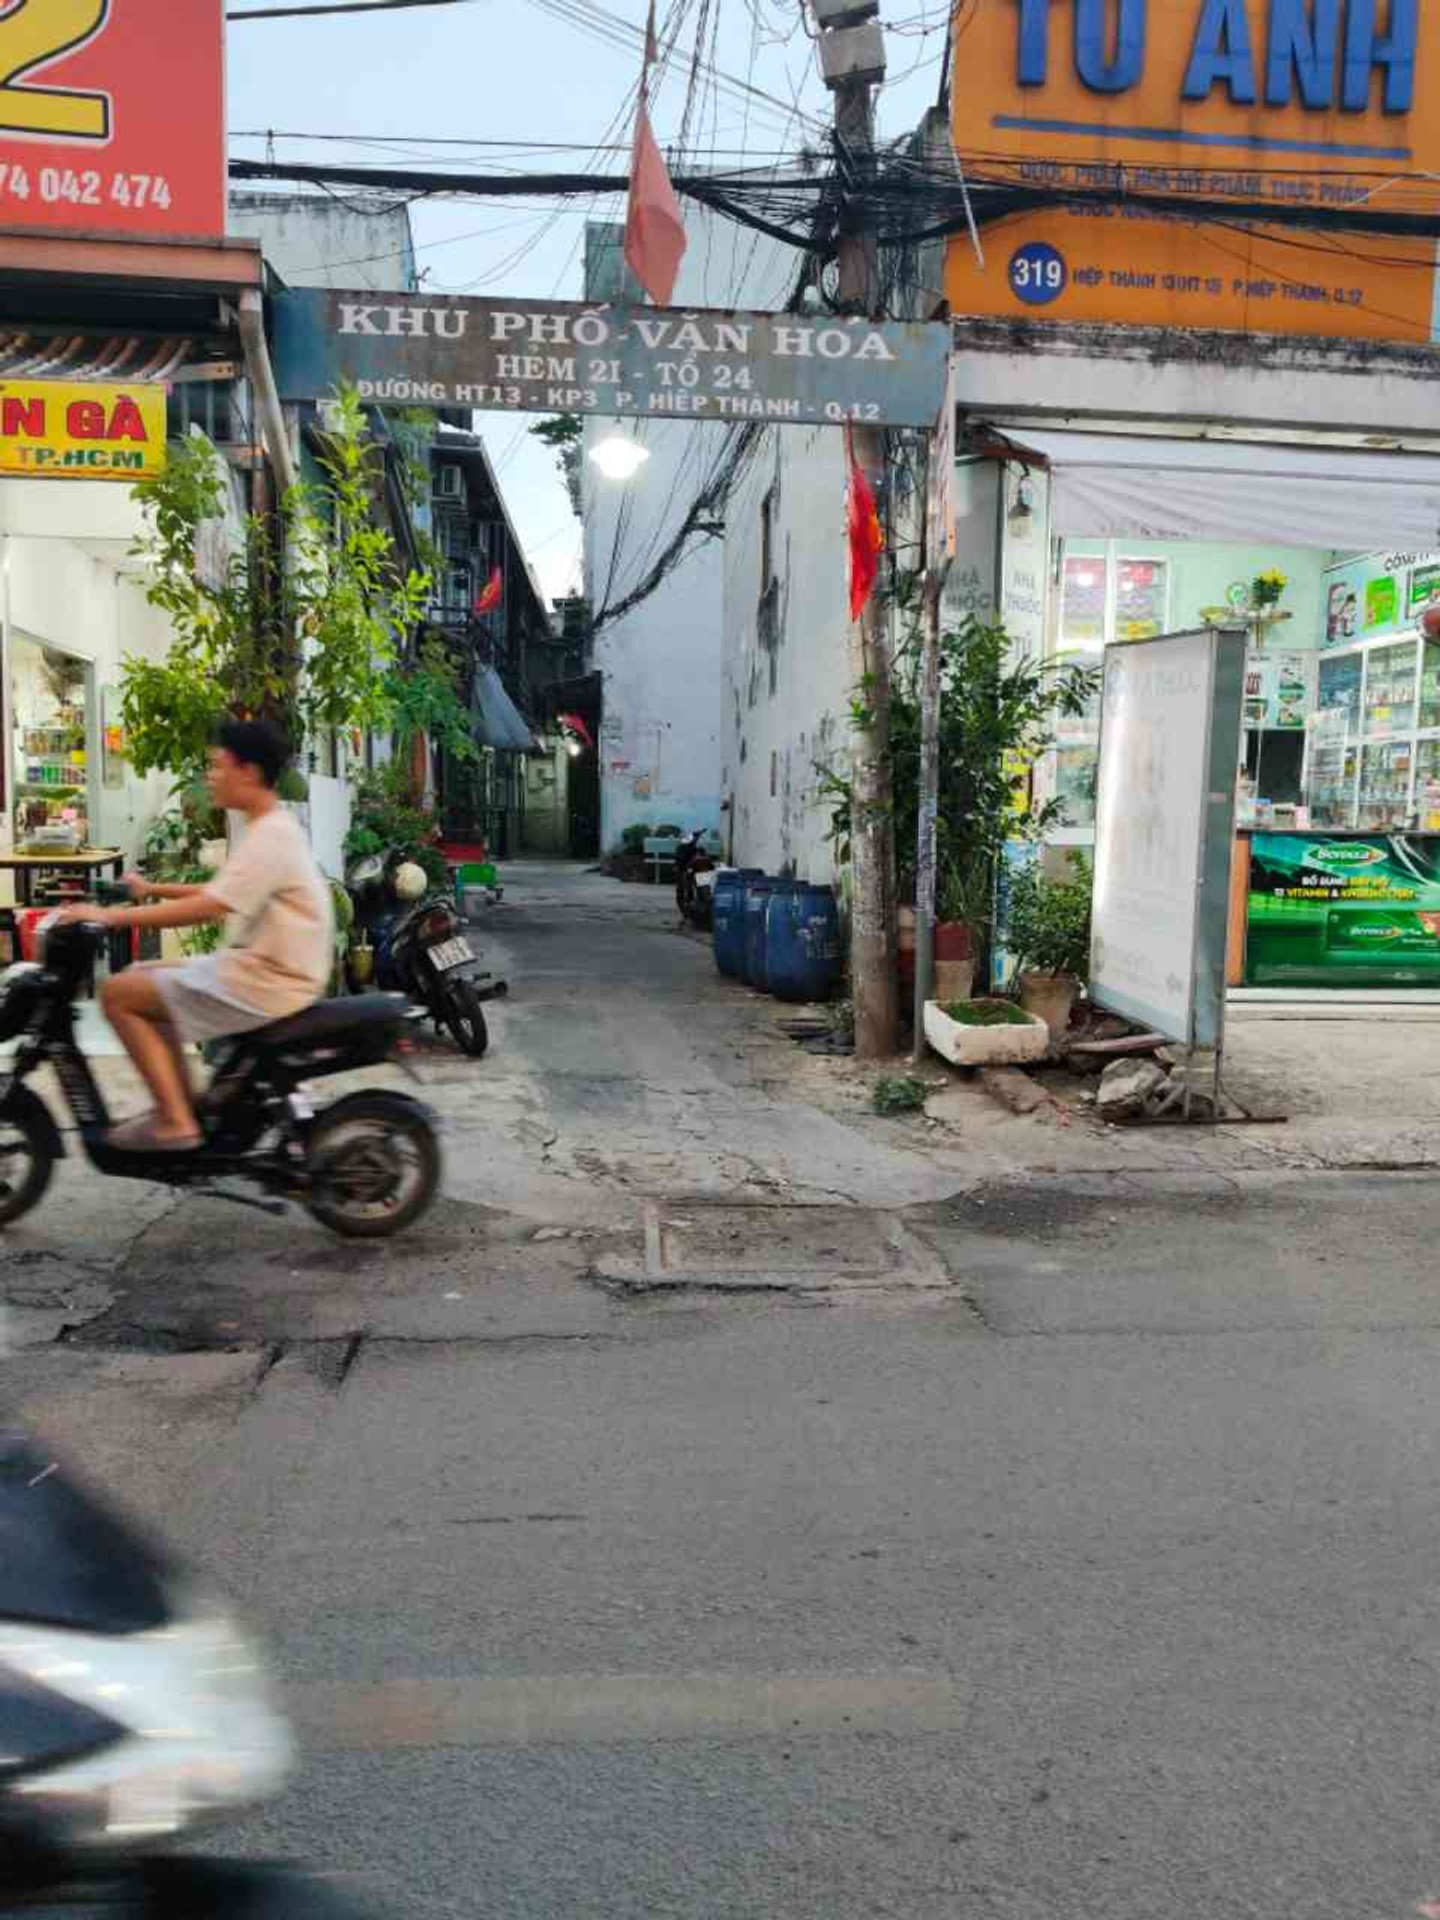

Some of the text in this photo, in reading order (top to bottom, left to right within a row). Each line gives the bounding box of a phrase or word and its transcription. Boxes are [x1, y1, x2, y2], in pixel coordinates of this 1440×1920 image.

[40, 167, 101, 205] 042
[111, 172, 171, 210] 474
[1014, 257, 1062, 288] 319
[338, 303, 470, 339] KHU
[490, 303, 611, 346] PHỐ
[633, 313, 753, 354] VĂN
[771, 316, 895, 361] HÓA
[655, 350, 700, 387] TỔ
[713, 364, 755, 390] 24
[66, 393, 147, 442] GÀ
[455, 383, 522, 404] HT13
[547, 388, 597, 408] KP3
[615, 391, 637, 409] P.
[715, 392, 799, 417] THÀNH
[825, 400, 880, 422] Q.12
[19, 445, 145, 469] TP.HCM
